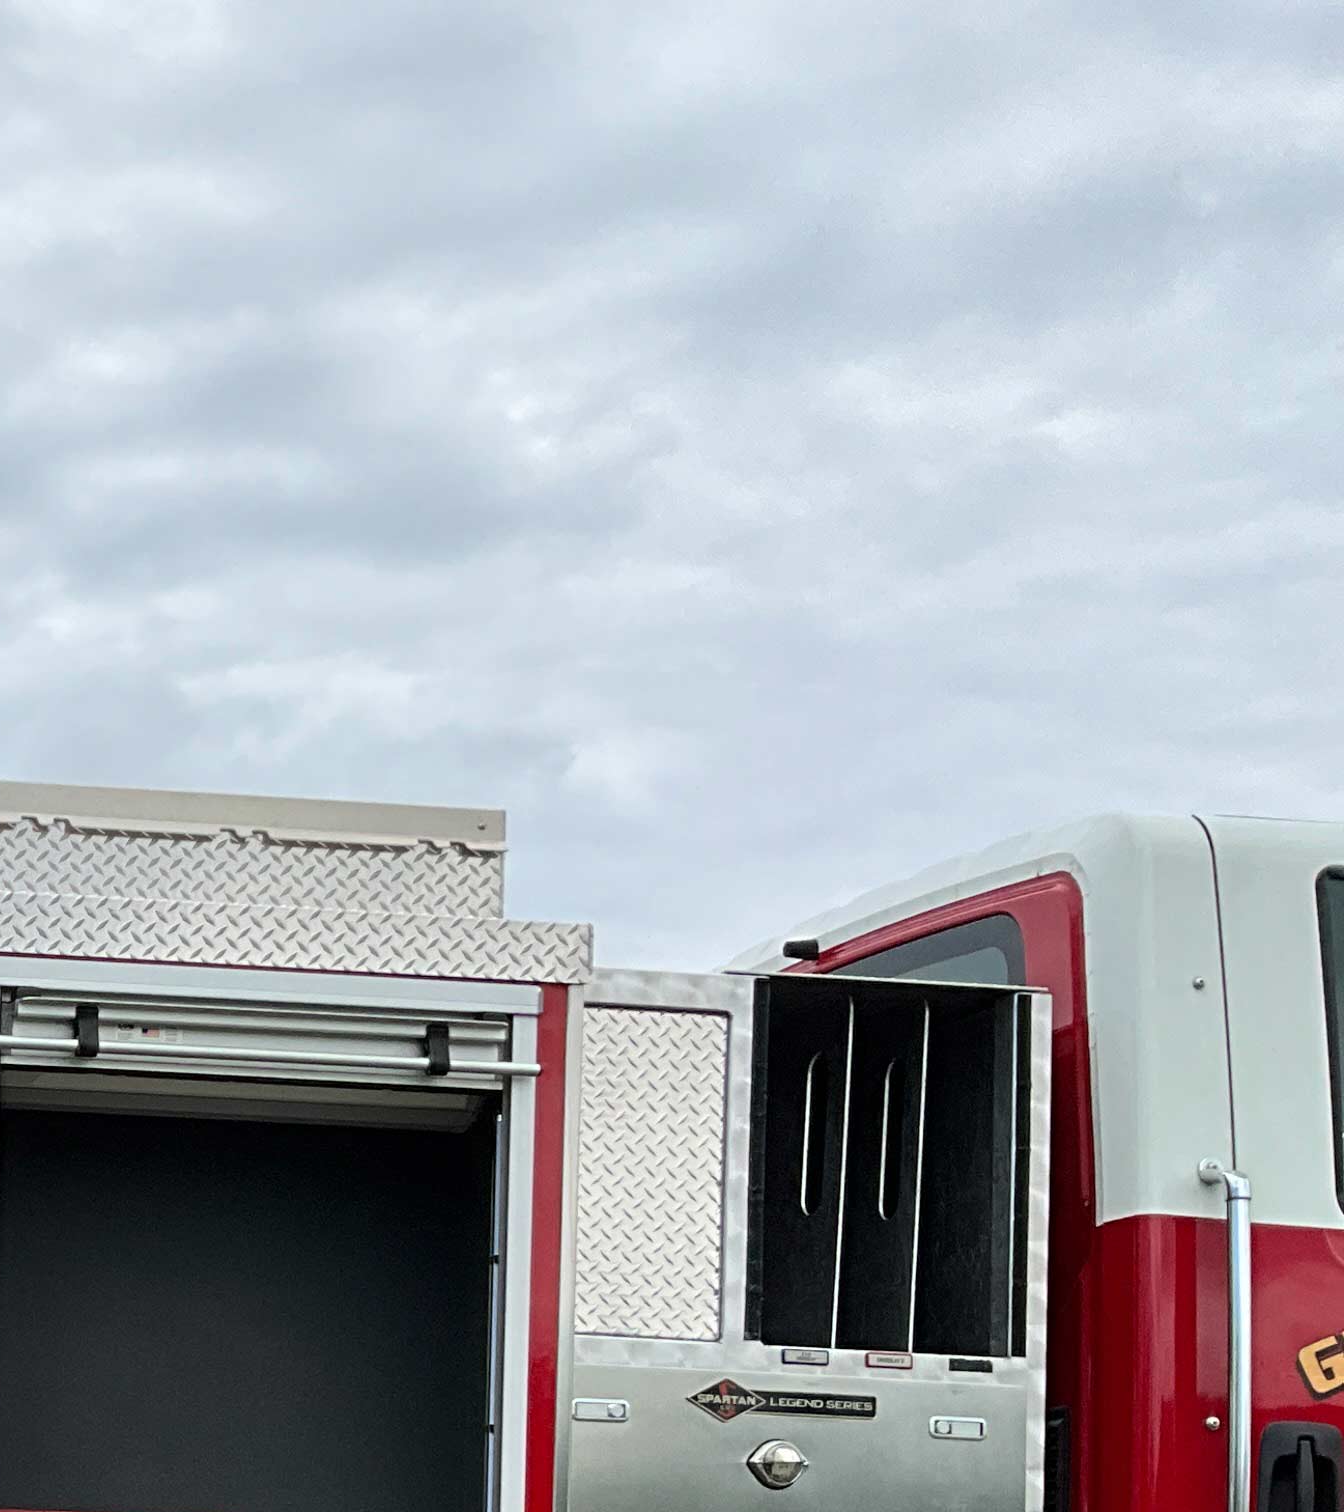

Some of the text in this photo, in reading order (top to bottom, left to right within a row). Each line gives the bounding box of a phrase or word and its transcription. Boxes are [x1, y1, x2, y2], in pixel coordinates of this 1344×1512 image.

[697, 1393, 756, 1406] SPARTAN
[770, 1397, 873, 1411] LEGEND SERIES
